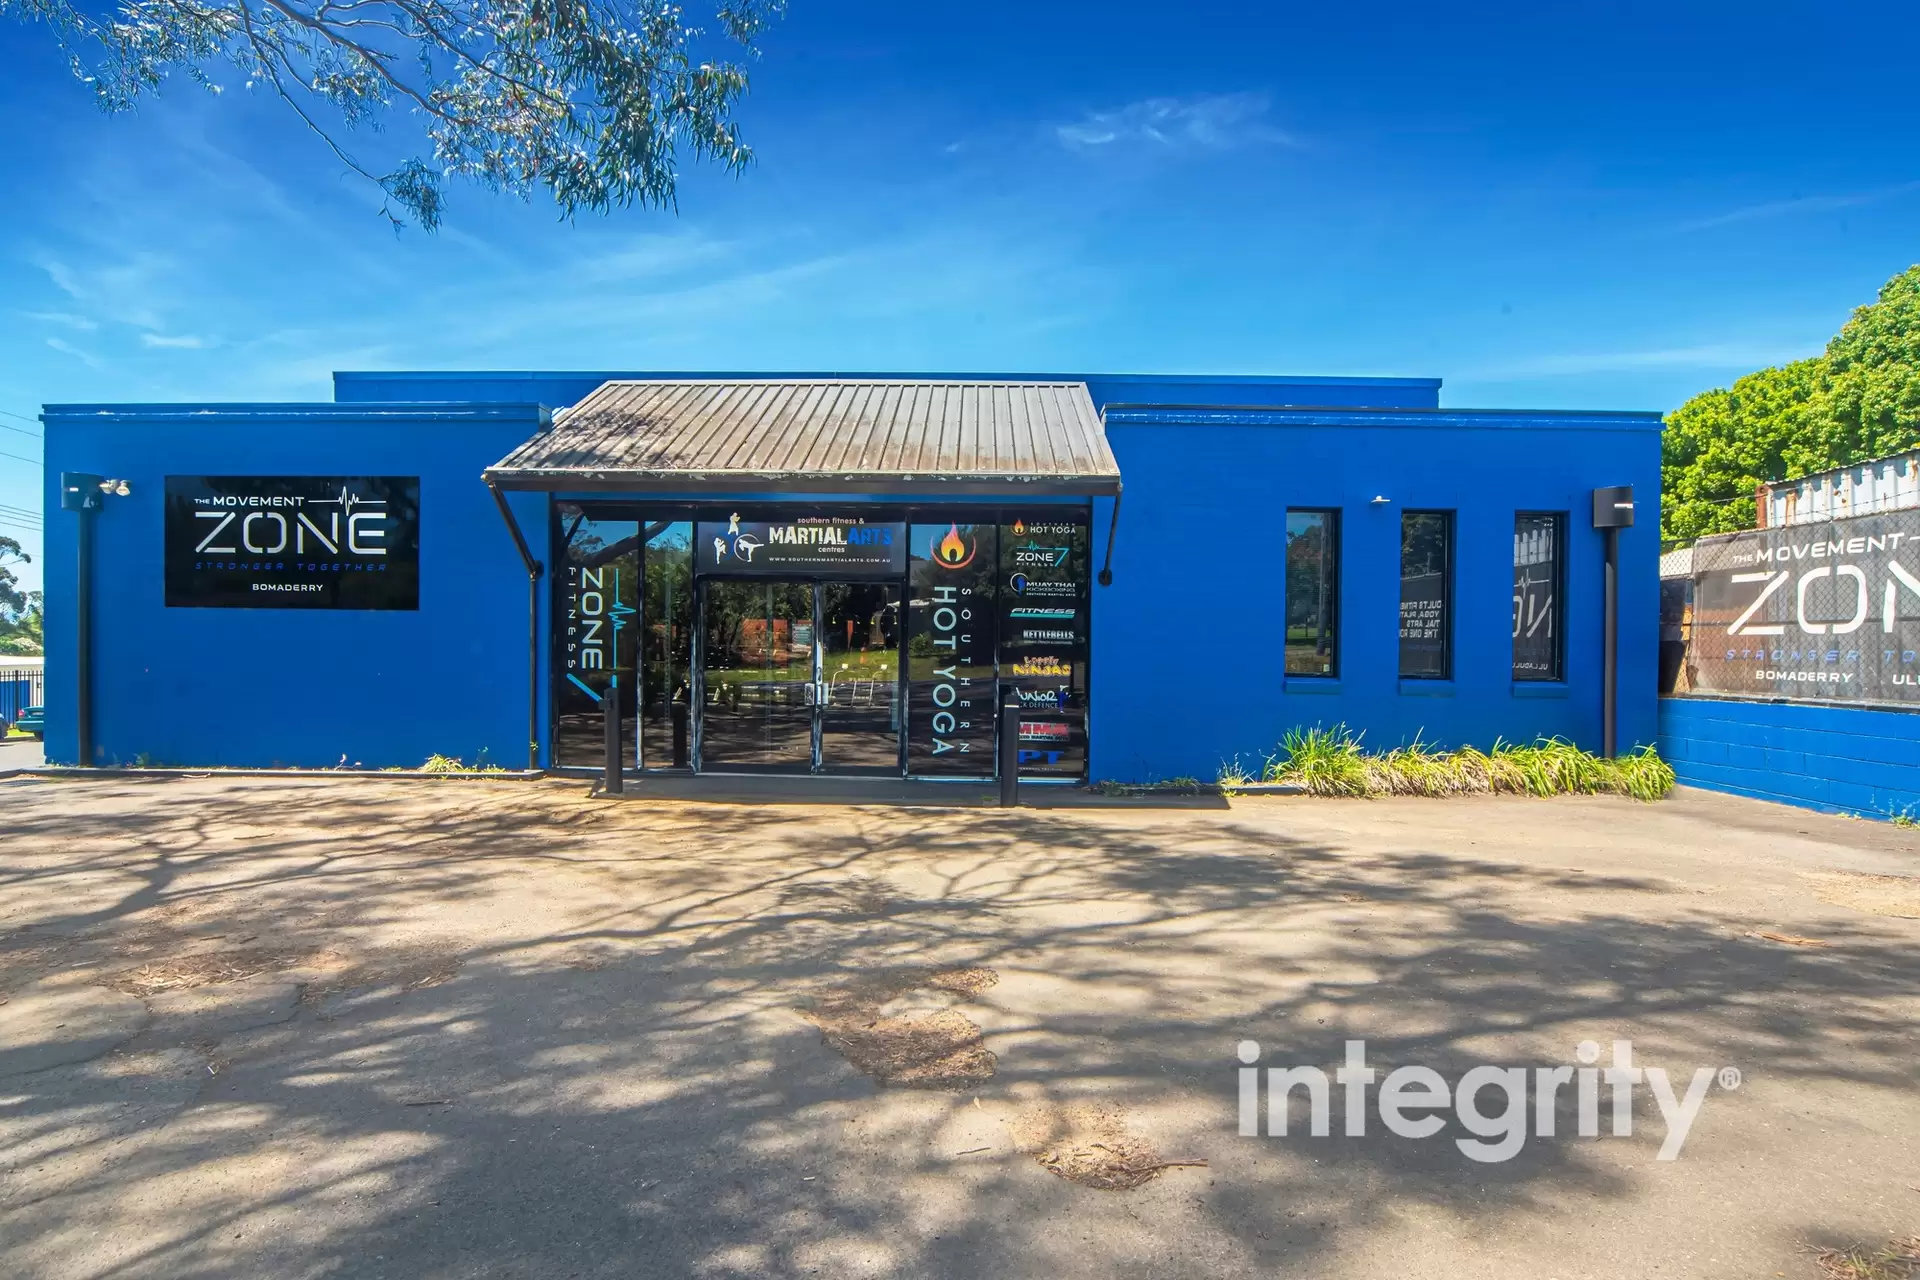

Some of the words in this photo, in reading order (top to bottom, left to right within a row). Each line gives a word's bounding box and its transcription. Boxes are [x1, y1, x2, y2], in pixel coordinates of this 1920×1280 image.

[213, 496, 305, 507] MOVEMENT
[195, 512, 387, 555] ZONE
[769, 526, 848, 545] MARTIAL
[848, 527, 893, 545] ARTS
[1030, 526, 1048, 534] HOT
[1051, 526, 1076, 534] YOGA
[1732, 554, 1753, 564] THE
[1756, 532, 1905, 563] MOVEMENT
[1016, 552, 1054, 562] ZONE
[195, 562, 284, 571] STRONGER
[297, 563, 387, 572] TOGETHER
[252, 583, 324, 592] BOMADERRY
[567, 567, 576, 669] FITNESS
[581, 567, 603, 670] ZONE
[933, 586, 957, 650] HOT
[1023, 630, 1075, 639] KETTLEBELLS
[1724, 650, 1861, 664] STRONGER
[960, 588, 972, 753] SOUTHERN
[1755, 670, 1854, 684] BOMADERRY
[932, 665, 956, 755] YOGA
[1028, 701, 1059, 709] DEFENCE
[1018, 749, 1065, 766] PT
